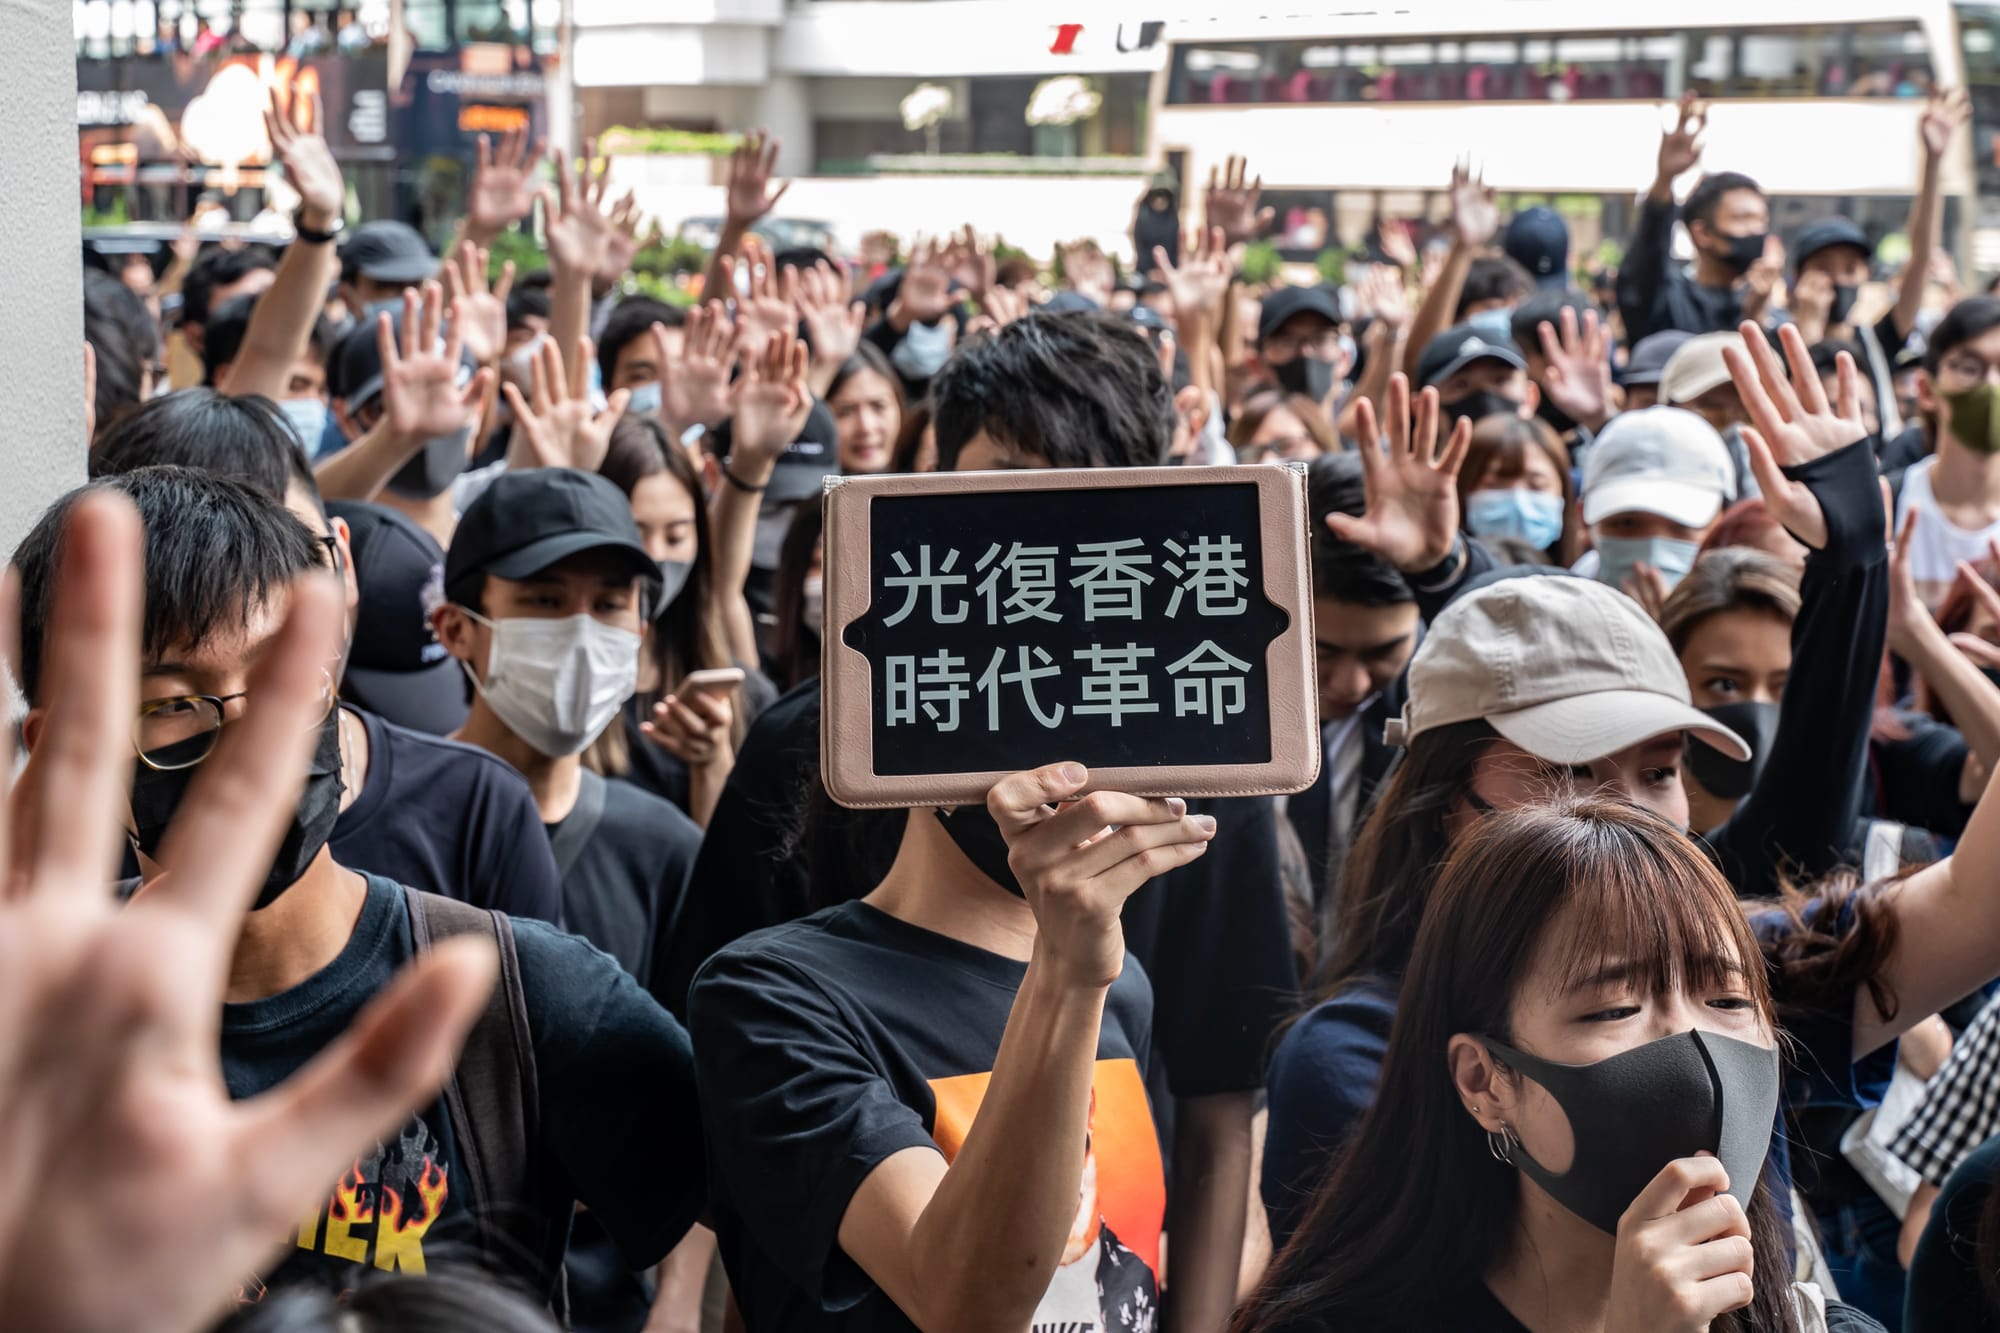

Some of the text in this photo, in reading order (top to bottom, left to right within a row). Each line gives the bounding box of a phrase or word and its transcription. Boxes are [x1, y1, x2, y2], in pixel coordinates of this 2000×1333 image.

[883, 535, 1250, 628] 光復香港
[886, 640, 1253, 732] 時代革命
